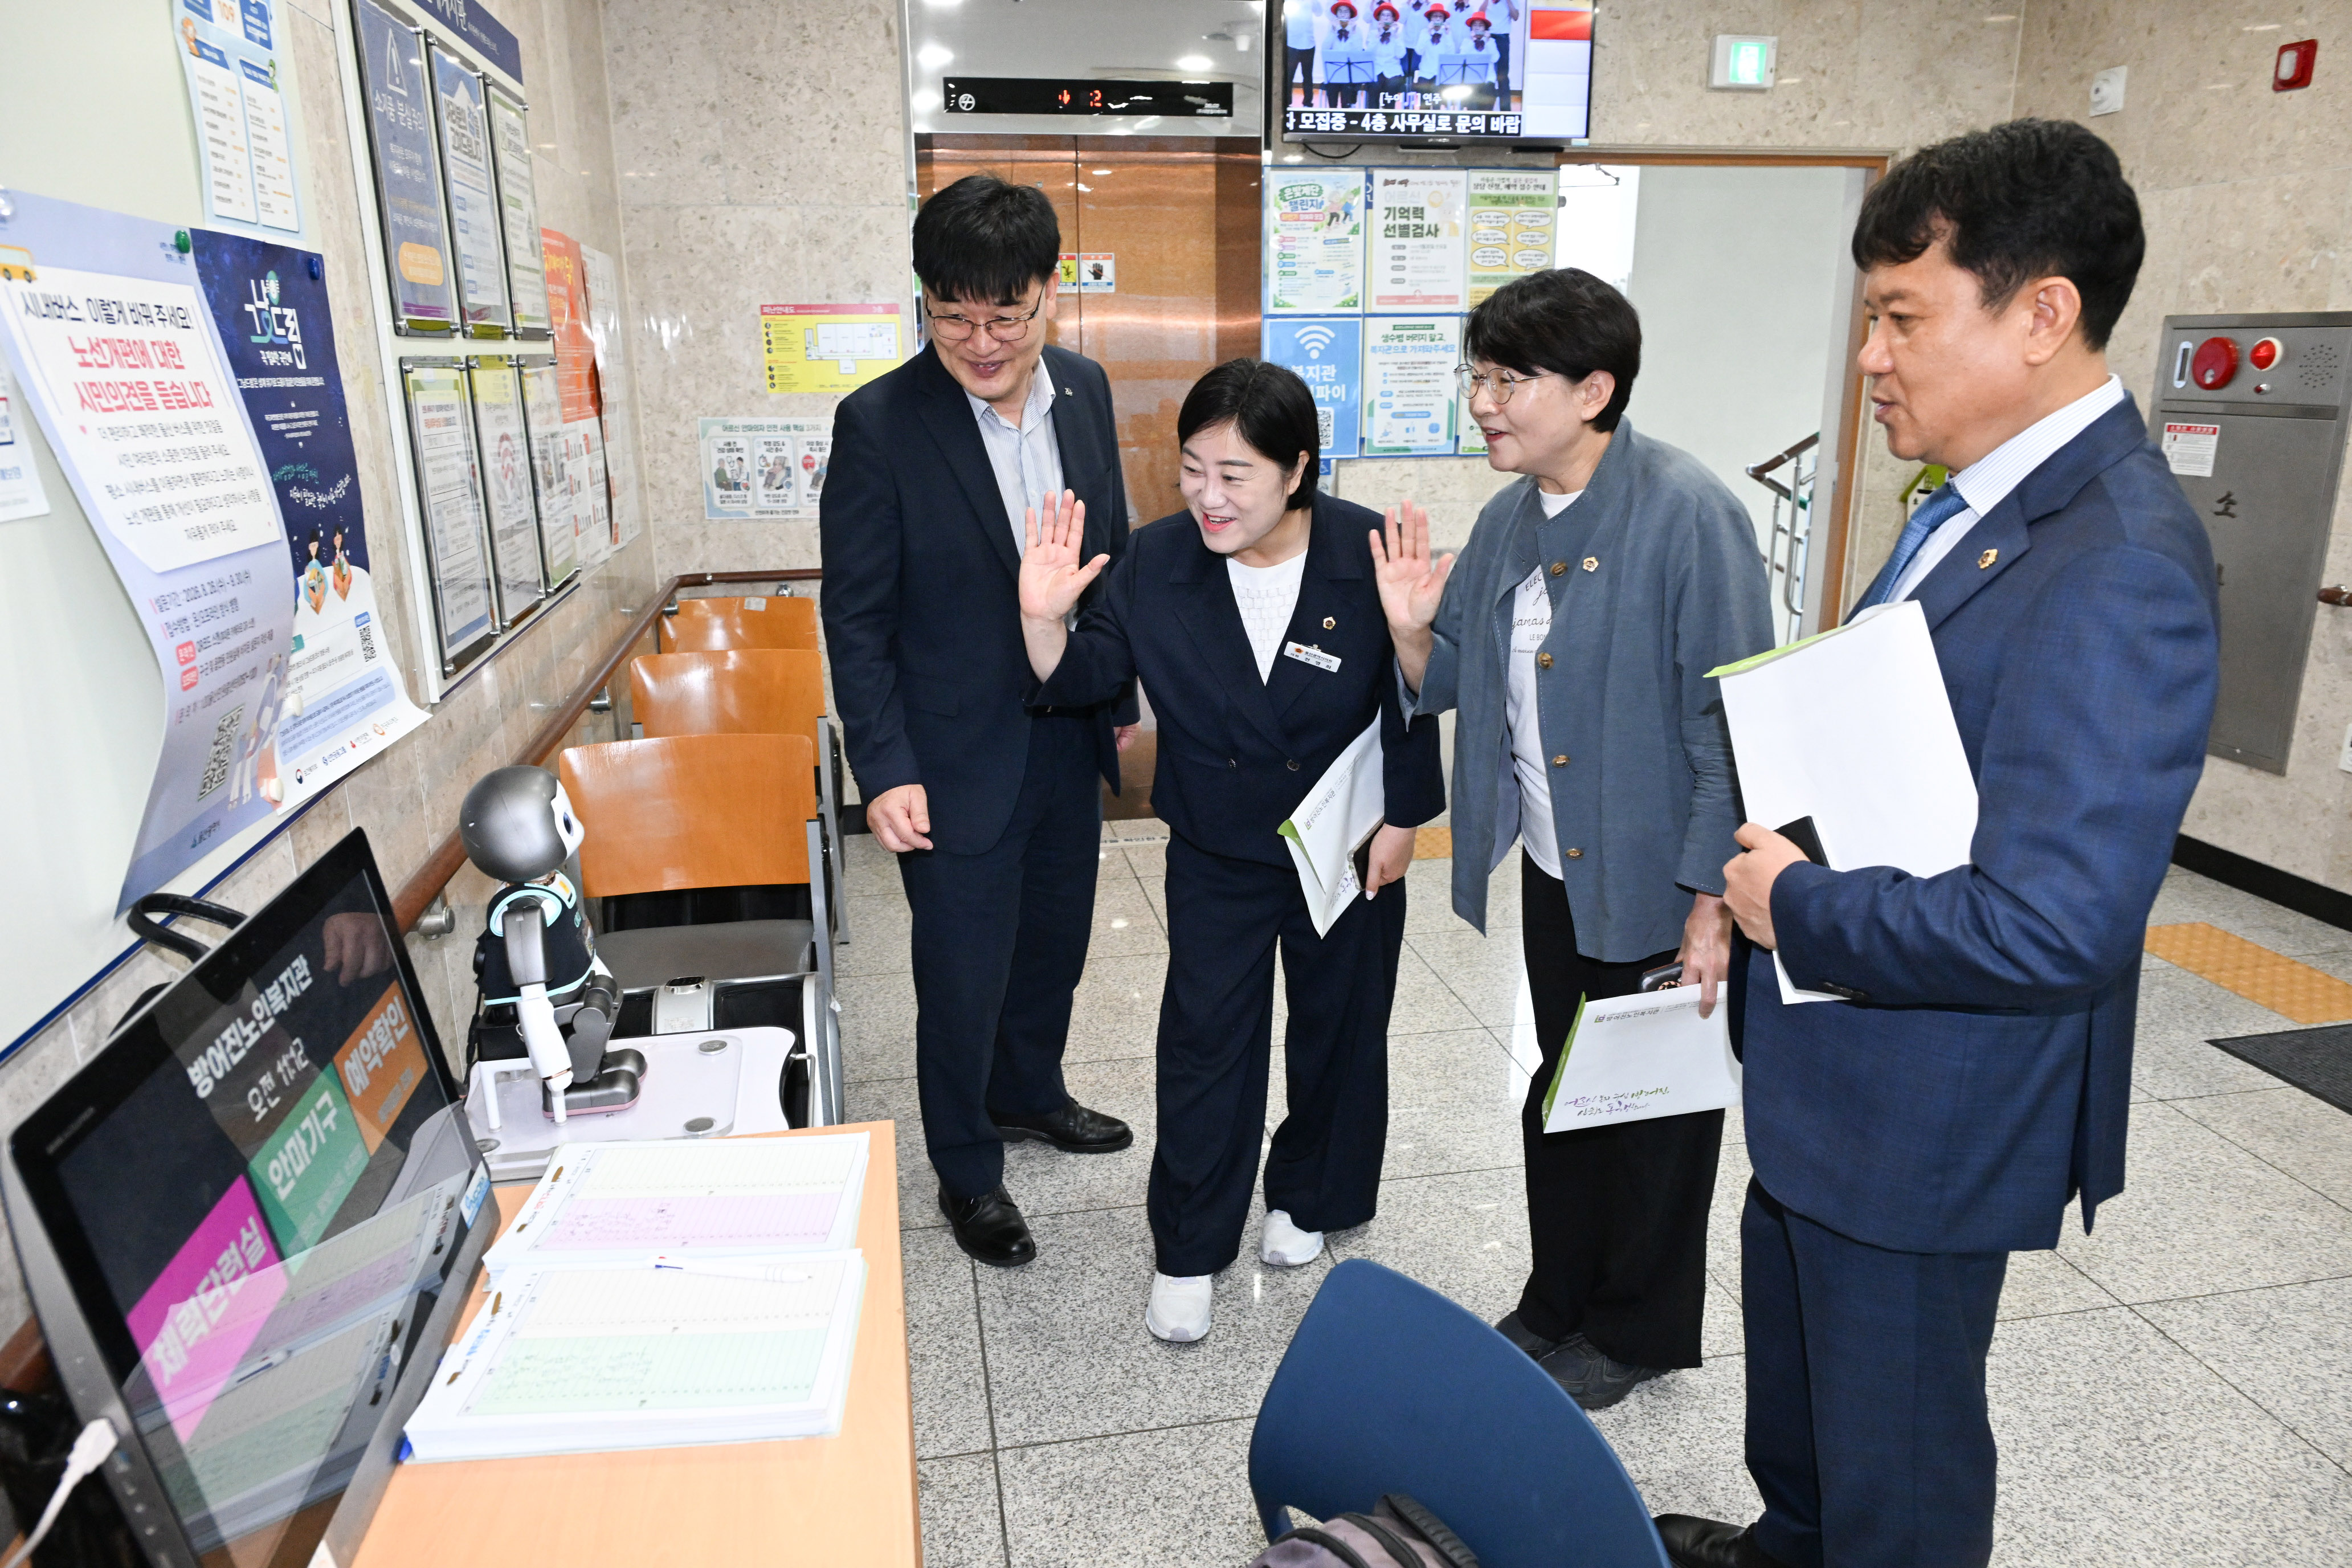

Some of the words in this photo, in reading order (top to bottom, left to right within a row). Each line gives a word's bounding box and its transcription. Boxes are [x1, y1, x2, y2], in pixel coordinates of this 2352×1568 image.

[1423, 93, 1442, 105] 연주
[1299, 112, 1346, 130] 모집중
[1361, 113, 1387, 131] 4층
[1390, 114, 1452, 132] 사무실로
[1455, 115, 1485, 132] 문의
[1491, 116, 1520, 133] 바랍
[1385, 191, 1420, 203] 어르신
[1384, 206, 1424, 220] 기억력
[1384, 224, 1439, 238] 선별검사
[86, 298, 129, 326] 이렇게
[127, 302, 155, 327] 바꿔
[154, 304, 194, 329] 주세요!
[1370, 345, 1407, 354] 복지관으로
[1381, 333, 1403, 342] 생수병
[1406, 333, 1427, 342] 버리지
[68, 336, 154, 369] 노선개편에
[150, 340, 185, 370] 대한
[1292, 365, 1337, 382] 복지관
[74, 381, 159, 413] 시민의견을
[153, 381, 214, 409] 듣습니다
[1310, 791, 1336, 823] 방어진노인복지관
[187, 954, 313, 1099] 방어진노인복지관
[1606, 1008, 1659, 1021] 방어진노인복지관
[345, 995, 409, 1097] 예약확인
[247, 1072, 281, 1122] 오전
[268, 1090, 338, 1201] 안마기구
[154, 1215, 266, 1387] 체력단련실
